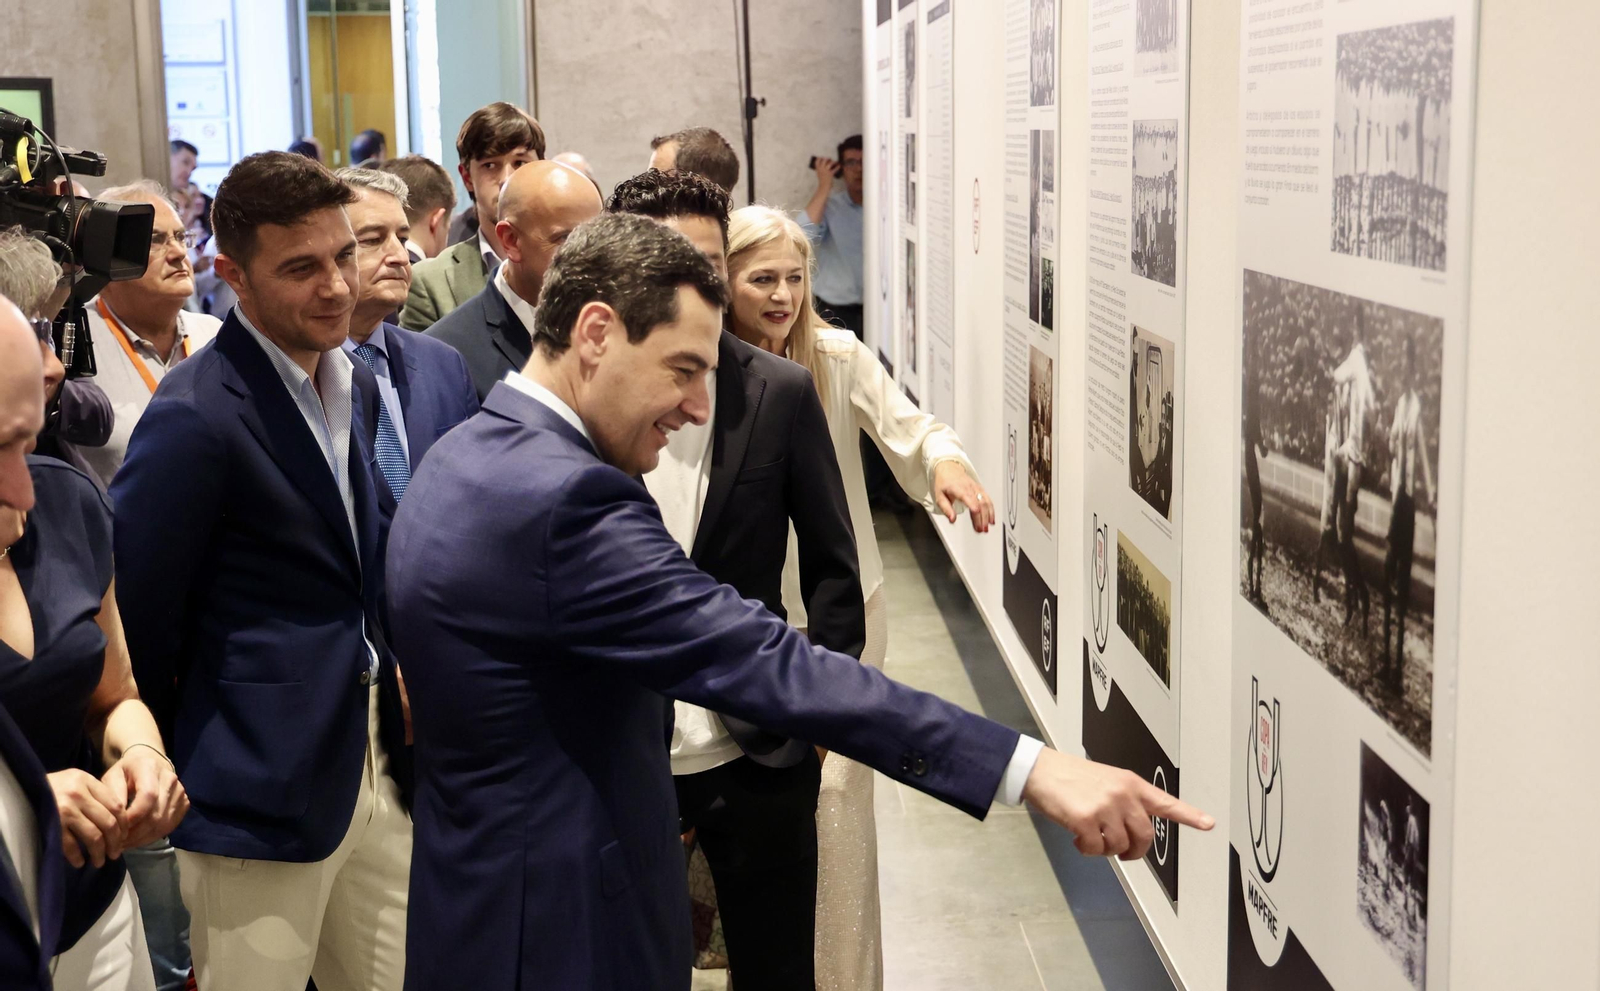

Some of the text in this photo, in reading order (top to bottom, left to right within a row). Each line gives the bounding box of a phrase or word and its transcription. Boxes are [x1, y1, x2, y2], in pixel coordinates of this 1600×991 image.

[1092, 656, 1108, 691] MAPFRE
[1155, 816, 1166, 842] EF
[1248, 880, 1278, 940] MAPFRE
